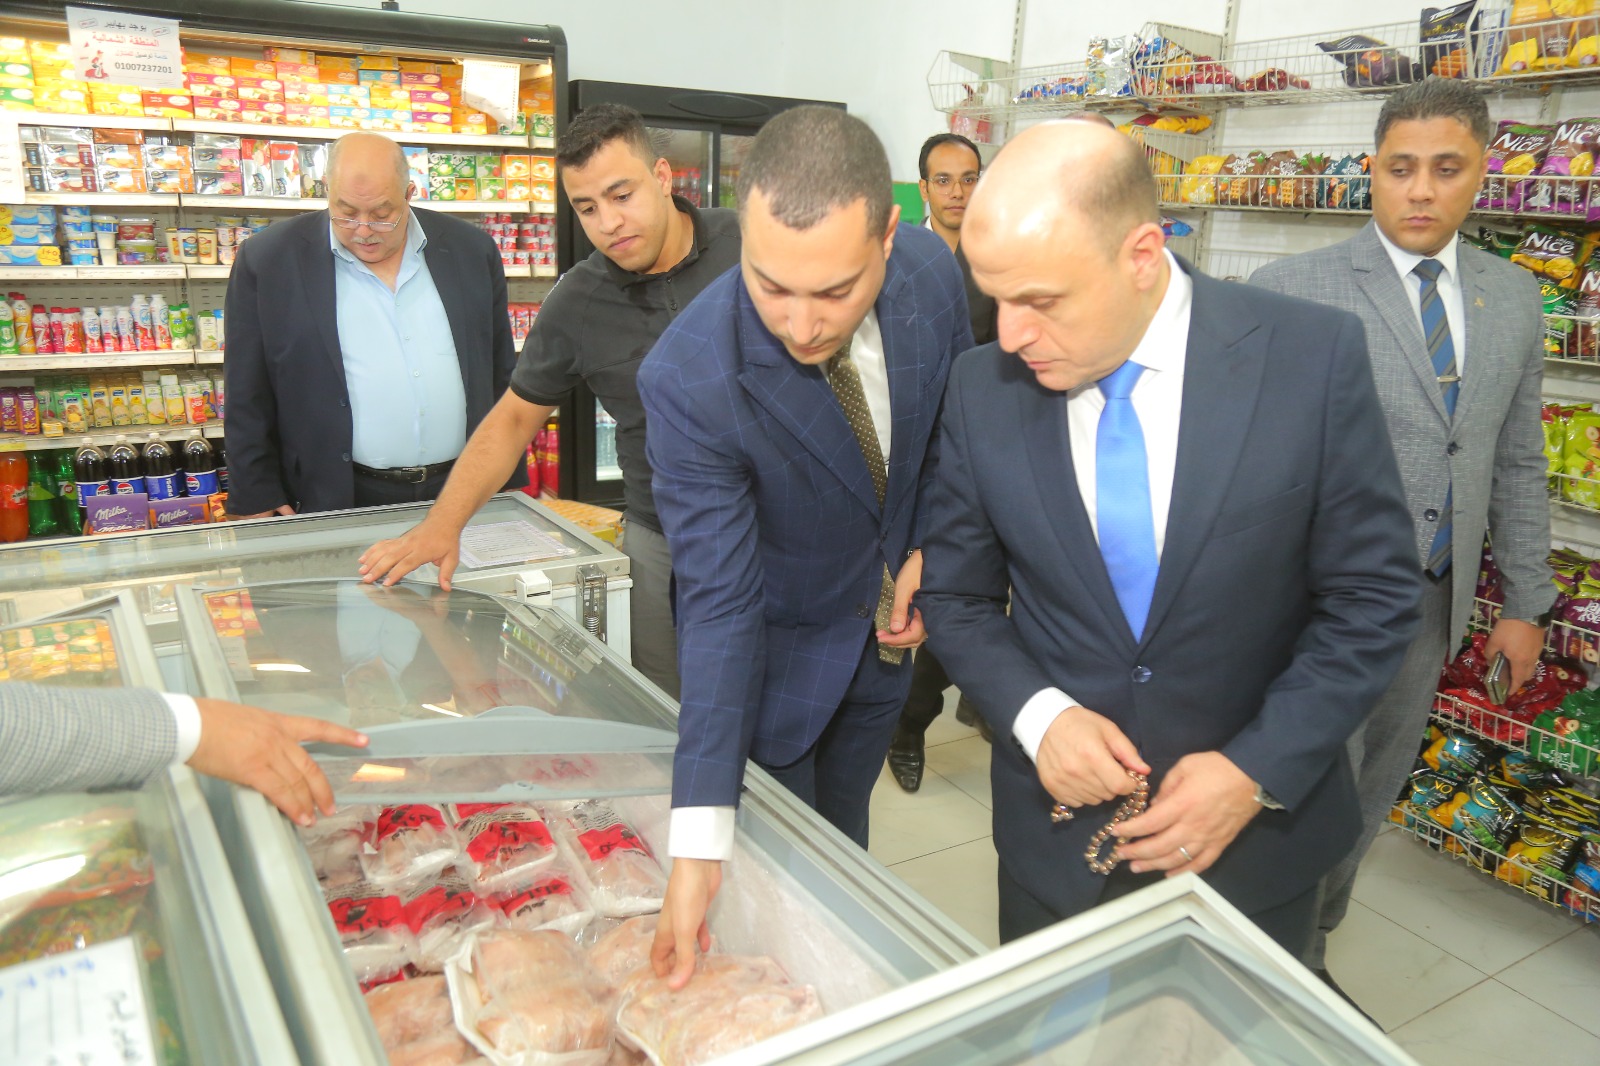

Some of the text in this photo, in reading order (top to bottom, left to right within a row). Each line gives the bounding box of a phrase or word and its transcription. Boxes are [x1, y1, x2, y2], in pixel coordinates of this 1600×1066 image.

[92, 31, 159, 47] المنطقة الشمالية
[115, 62, 172, 74] 01007237201
[1493, 133, 1543, 151] Nice
[1552, 123, 1600, 145] Nic
[1525, 232, 1574, 254] Nice
[95, 506, 128, 520] Milka
[157, 509, 189, 523] Milka
